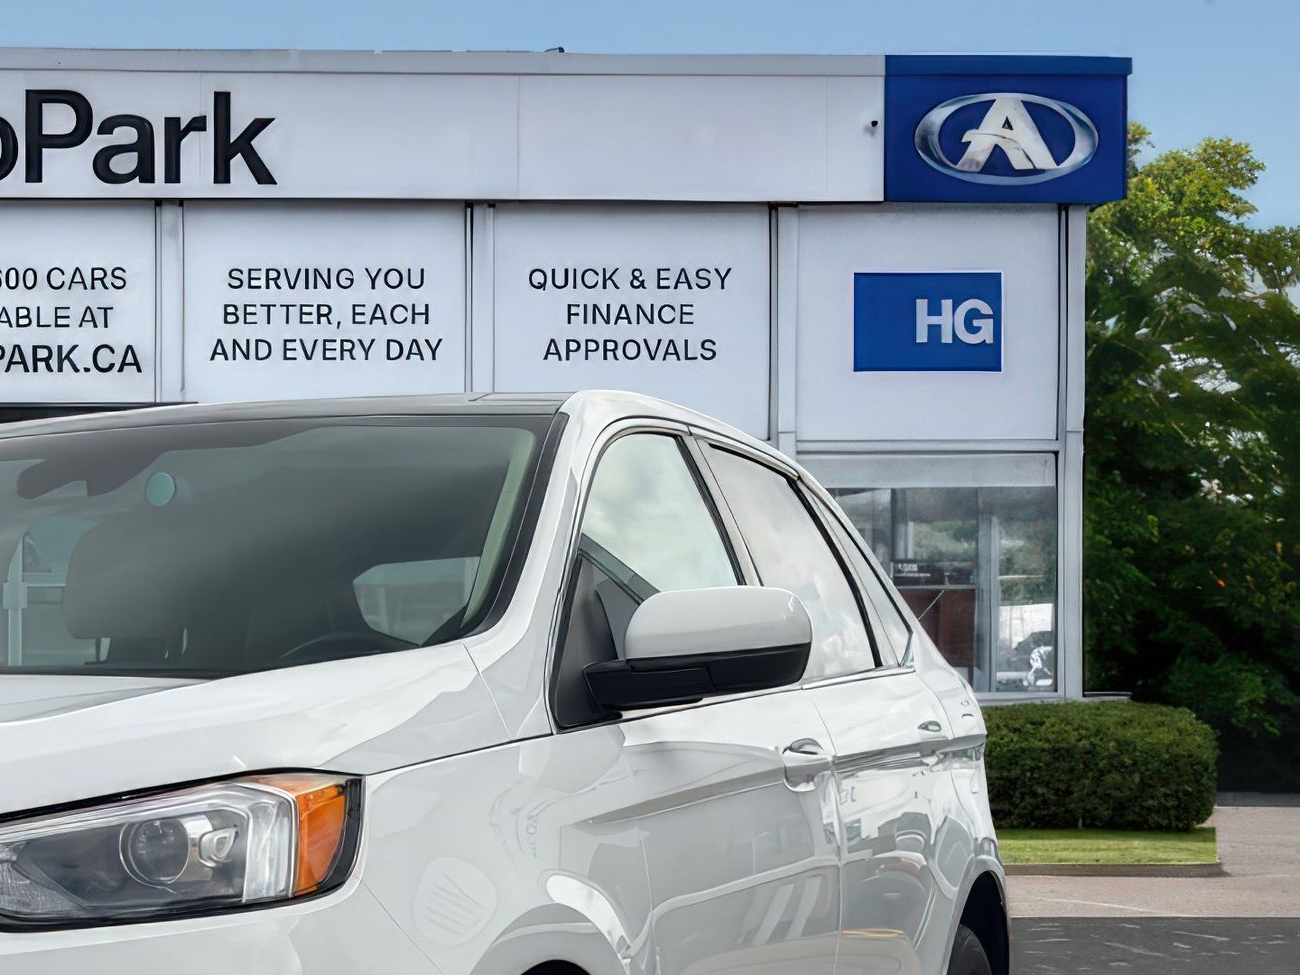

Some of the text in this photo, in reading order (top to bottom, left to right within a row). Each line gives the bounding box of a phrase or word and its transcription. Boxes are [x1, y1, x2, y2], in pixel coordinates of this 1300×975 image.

[46, 266, 127, 291] CARS
[227, 267, 425, 290] SERVING YOU
[528, 267, 732, 292] QUICK & EASY
[78, 305, 114, 329] AT
[223, 303, 430, 330] BETTER, EACH
[567, 303, 694, 326] FINANCE
[915, 298, 994, 344] HG
[209, 338, 443, 361] AND EVERY DAY
[542, 338, 717, 362] APPROVALS
